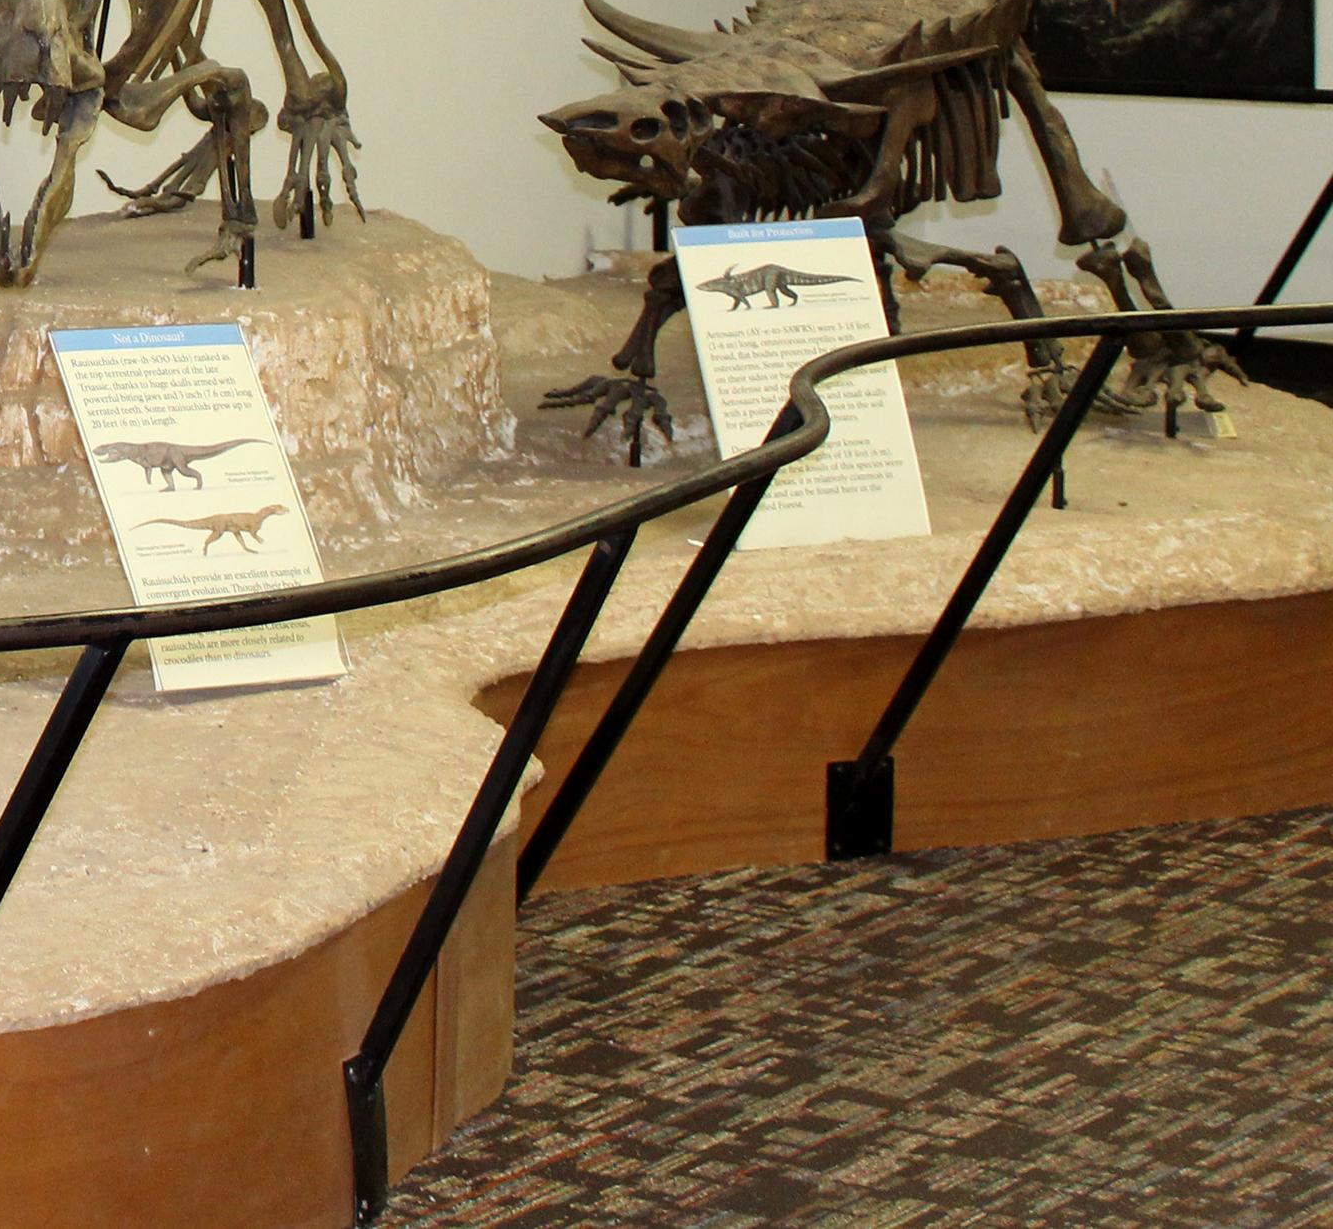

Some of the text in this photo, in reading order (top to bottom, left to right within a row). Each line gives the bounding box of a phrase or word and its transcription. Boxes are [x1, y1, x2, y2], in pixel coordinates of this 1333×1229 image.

[112, 333, 132, 344] Not
[75, 371, 89, 380] the
[89, 371, 103, 381] top
[104, 367, 143, 378] terrestrial
[144, 367, 180, 378] predators
[191, 365, 205, 374] the
[205, 365, 219, 374] late
[103, 419, 119, 428] feet
[129, 418, 141, 427] m)
[150, 416, 177, 427] length.
